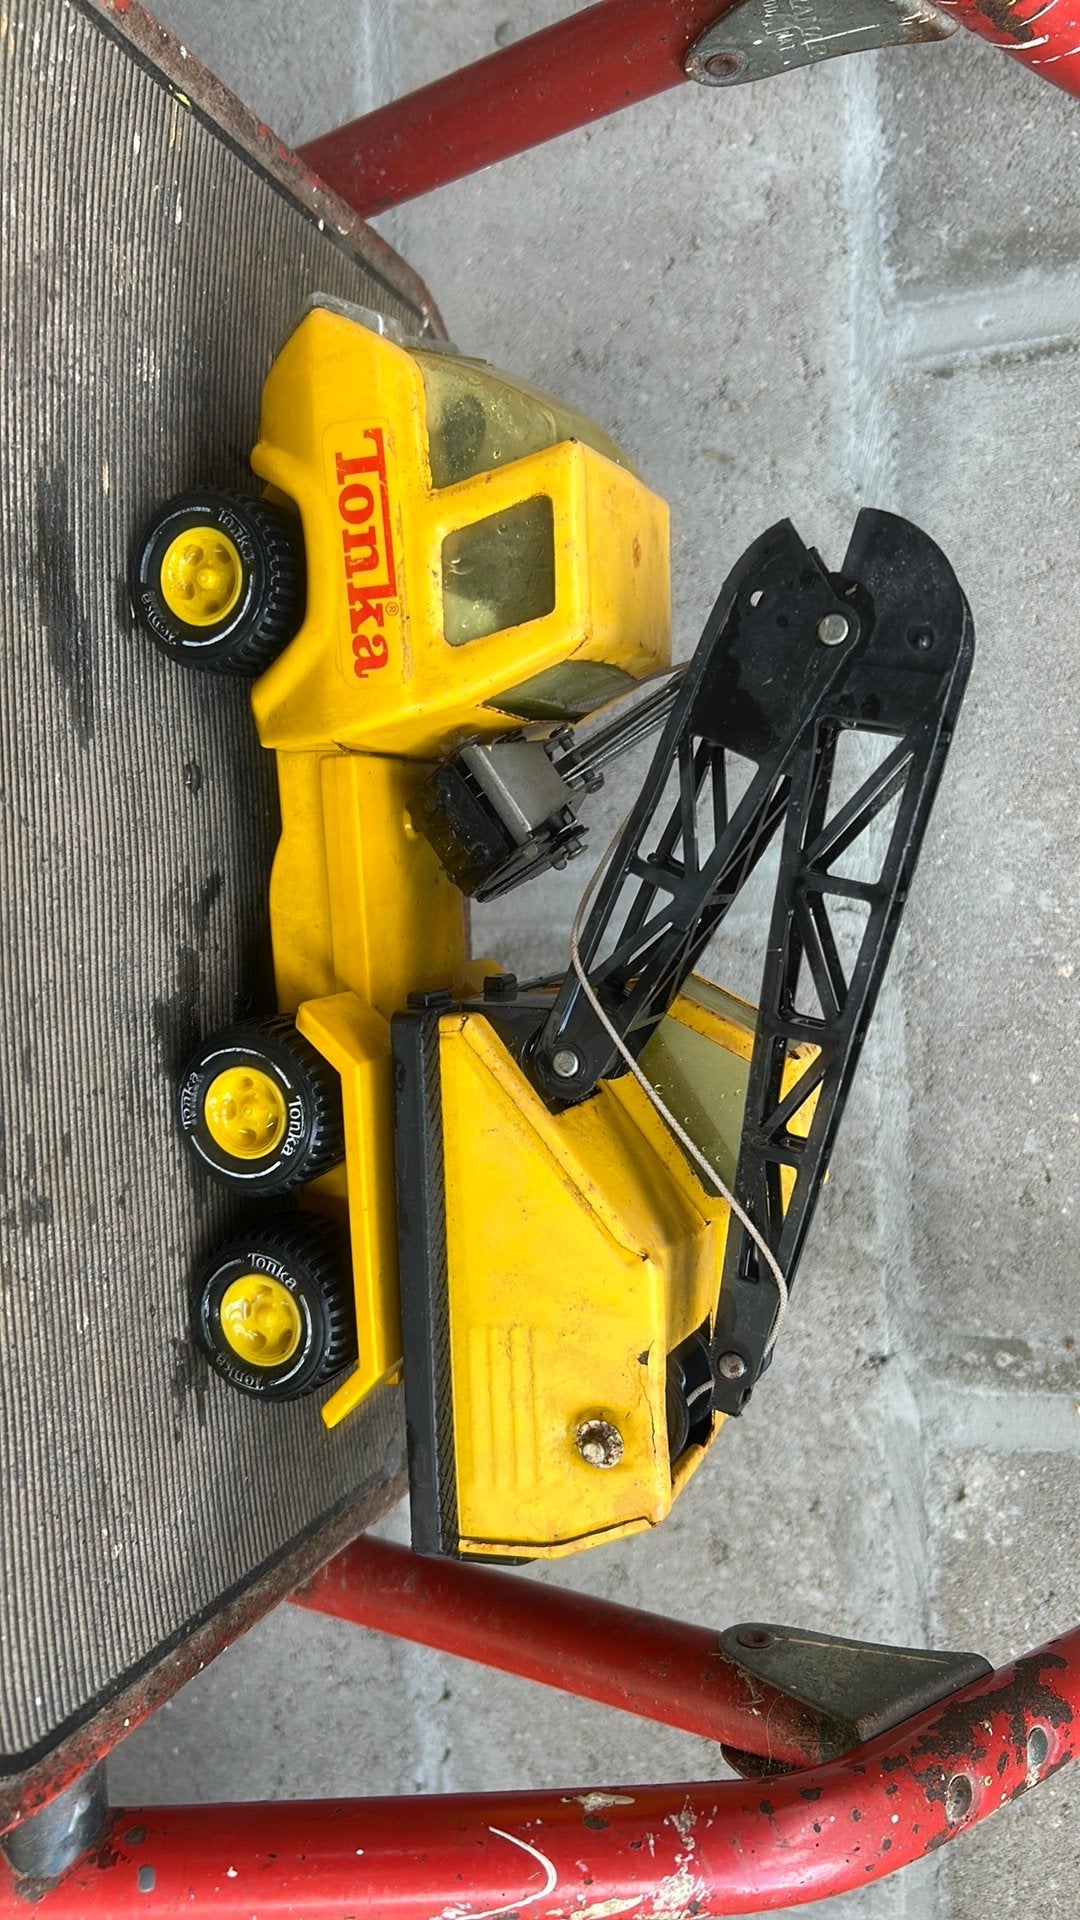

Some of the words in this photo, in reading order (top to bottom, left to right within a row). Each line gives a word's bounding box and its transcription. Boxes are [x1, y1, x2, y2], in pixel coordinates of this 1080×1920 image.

[335, 428, 398, 679] Tonka
[181, 1072, 203, 1130] Tonka
[280, 1094, 306, 1156] Tonka
[247, 1252, 298, 1291] Tonka
